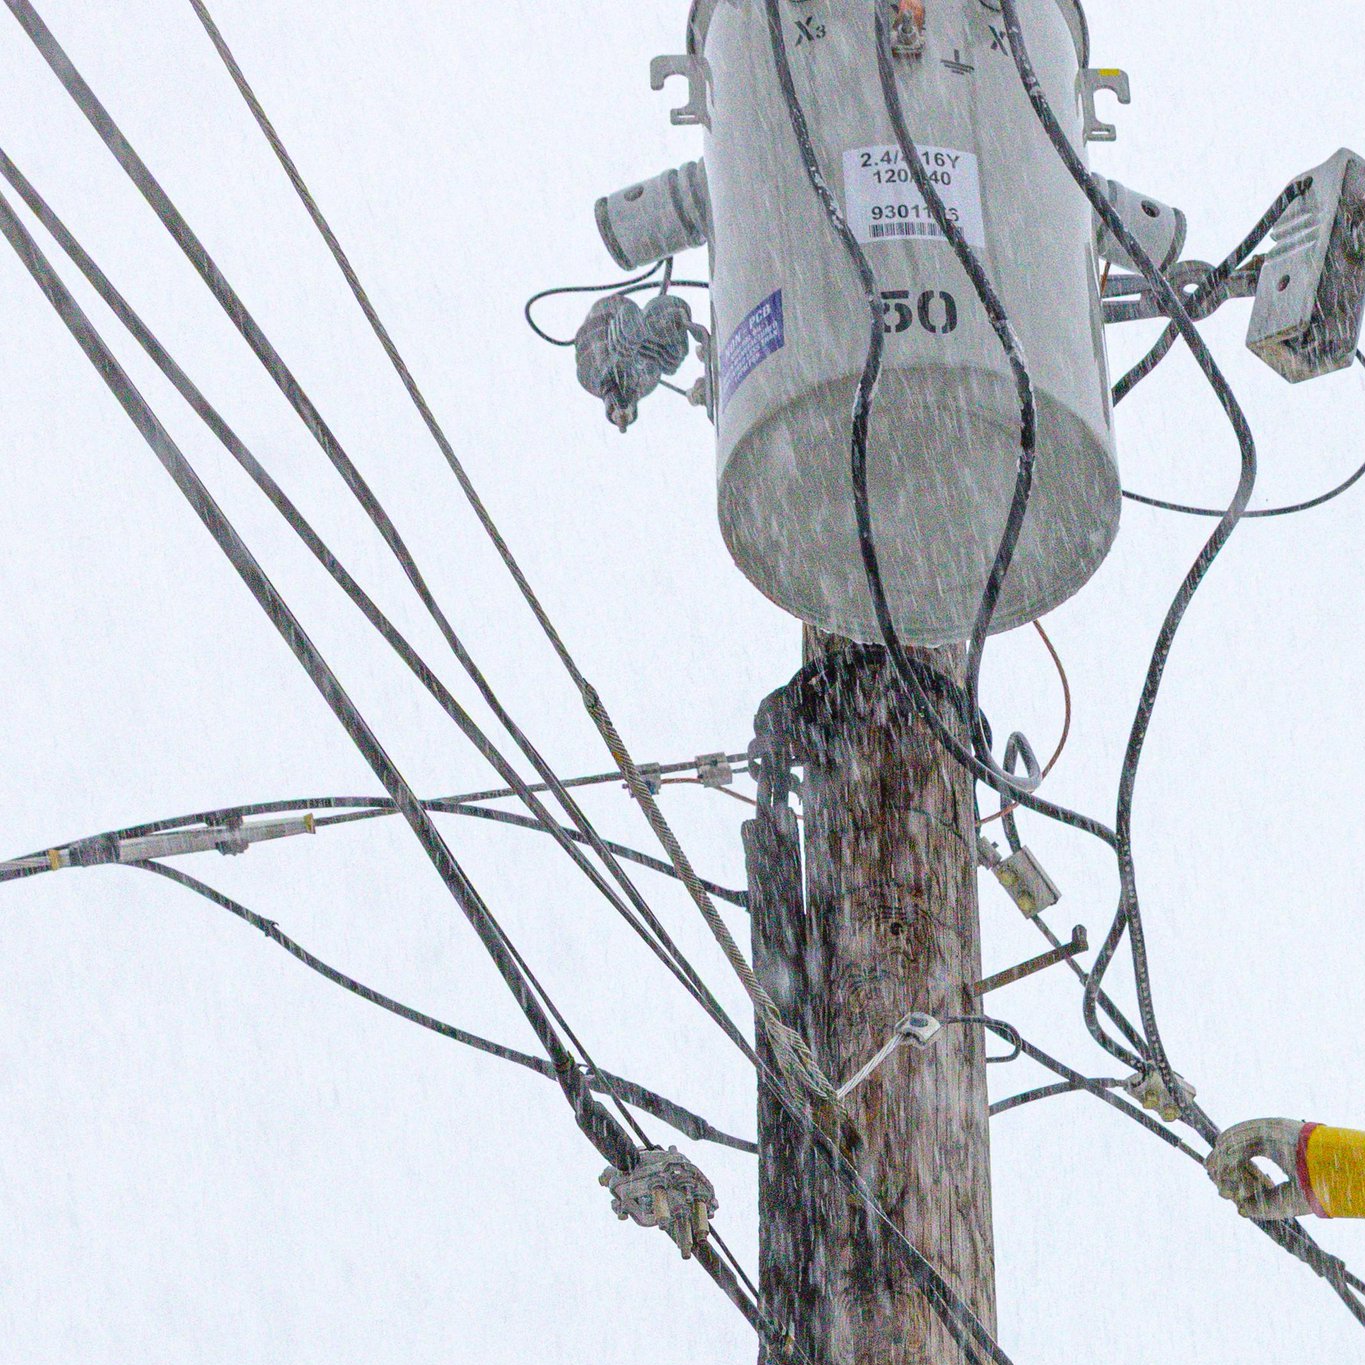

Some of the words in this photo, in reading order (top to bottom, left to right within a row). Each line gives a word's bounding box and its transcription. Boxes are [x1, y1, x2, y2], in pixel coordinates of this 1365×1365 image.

[794, 16, 826, 47] X3
[860, 150, 960, 169] 2.4/16Y
[880, 290, 957, 333] 50
